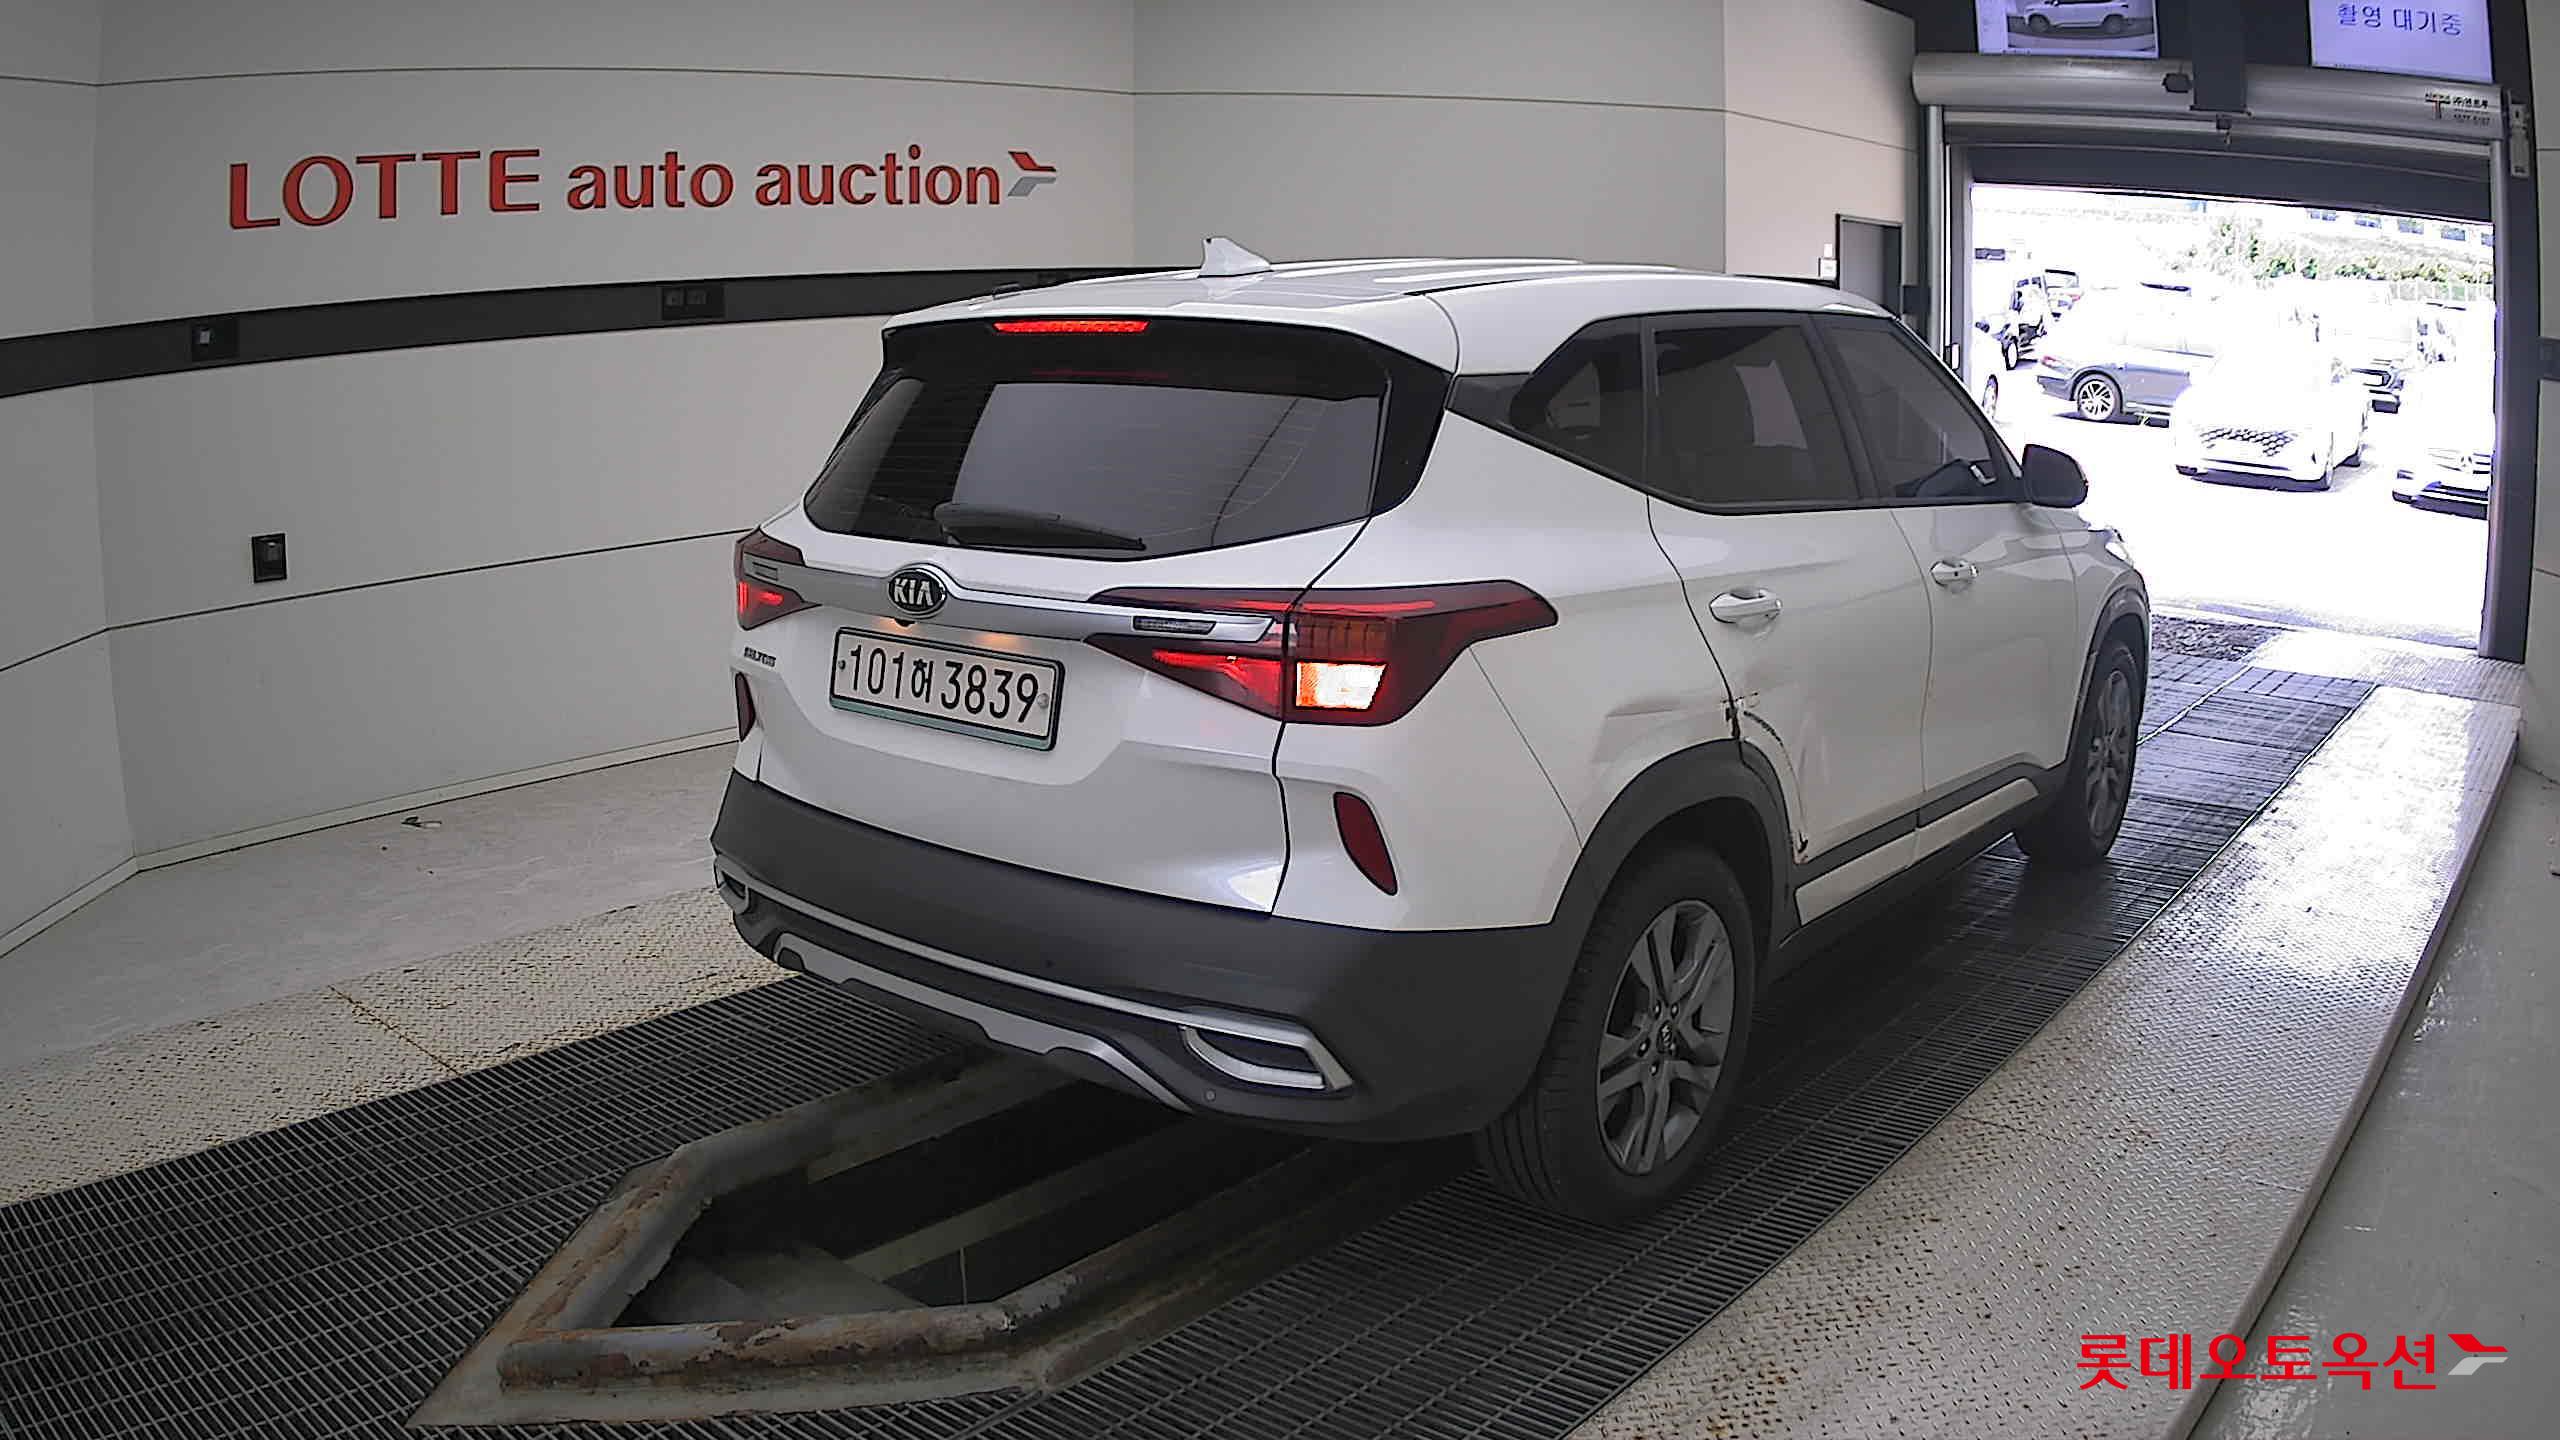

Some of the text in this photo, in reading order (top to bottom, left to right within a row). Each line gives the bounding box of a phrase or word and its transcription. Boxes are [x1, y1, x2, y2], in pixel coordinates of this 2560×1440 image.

[2338, 4, 2462, 36] 촬영 대기중
[229, 144, 1001, 230] LOTTE auto auction
[893, 576, 935, 608] KIA
